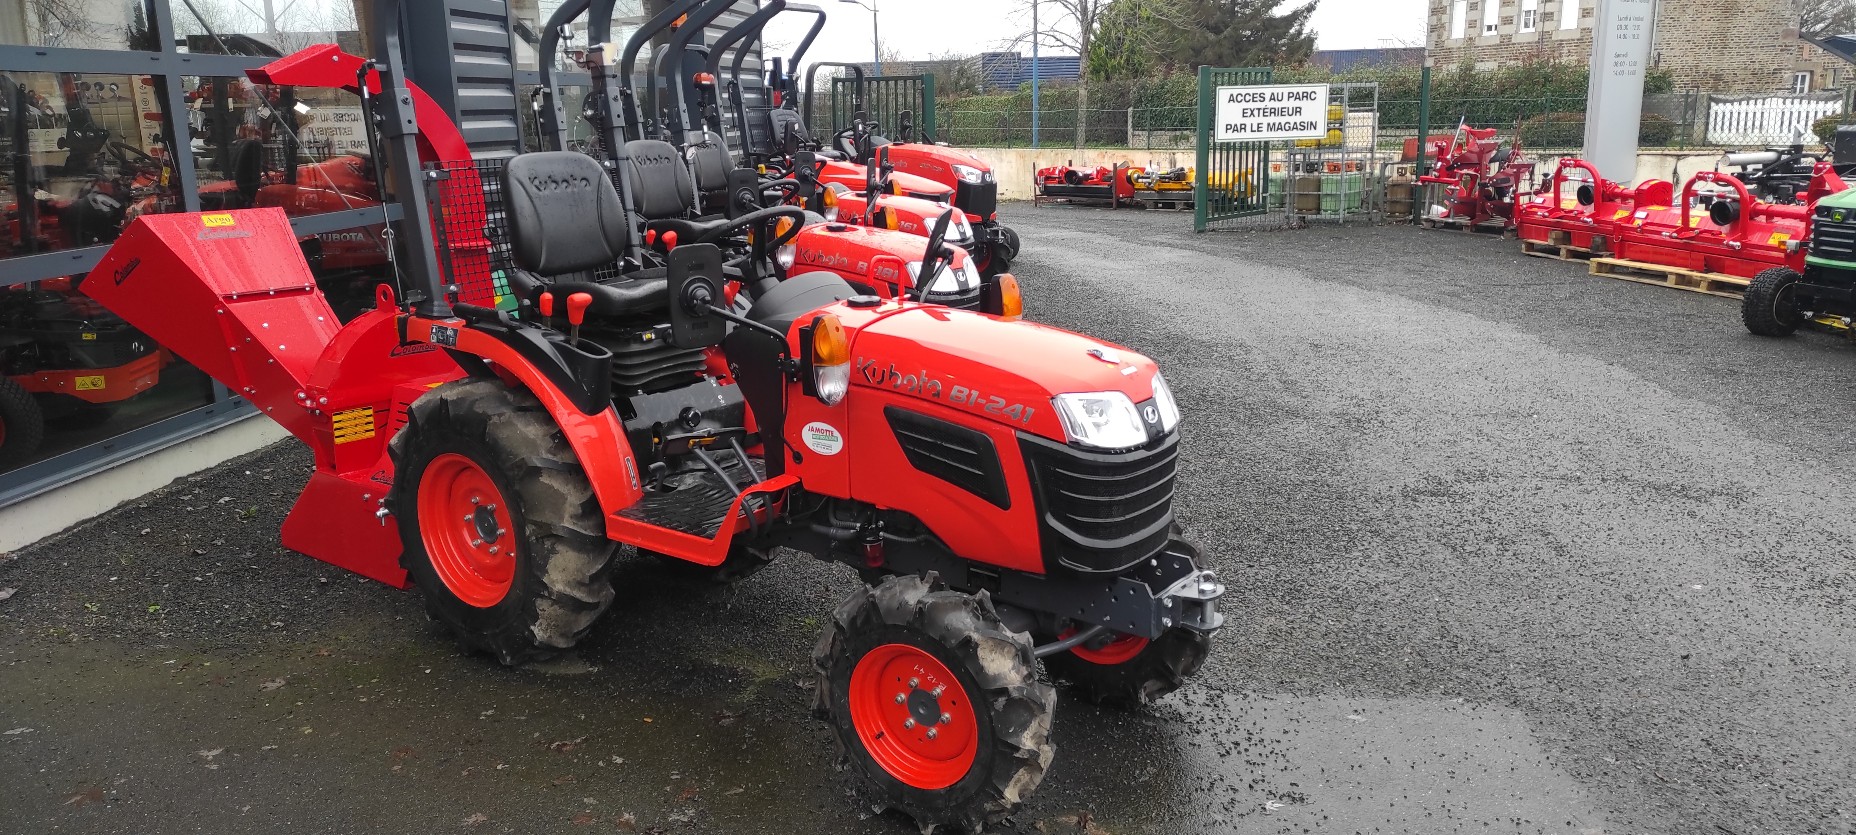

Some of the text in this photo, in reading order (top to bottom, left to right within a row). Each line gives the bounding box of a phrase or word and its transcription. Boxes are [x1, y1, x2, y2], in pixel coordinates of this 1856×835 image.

[1228, 90, 1317, 103] ACCES AU PARC
[1242, 105, 1302, 118] EXTÉRIEUR
[1225, 121, 1318, 133] PAR LE MAGASIN
[528, 174, 590, 192] Kubota
[800, 247, 848, 267] Kubota
[856, 356, 1035, 424] Kubota B1-241
[807, 425, 834, 437] JAMOTTE
